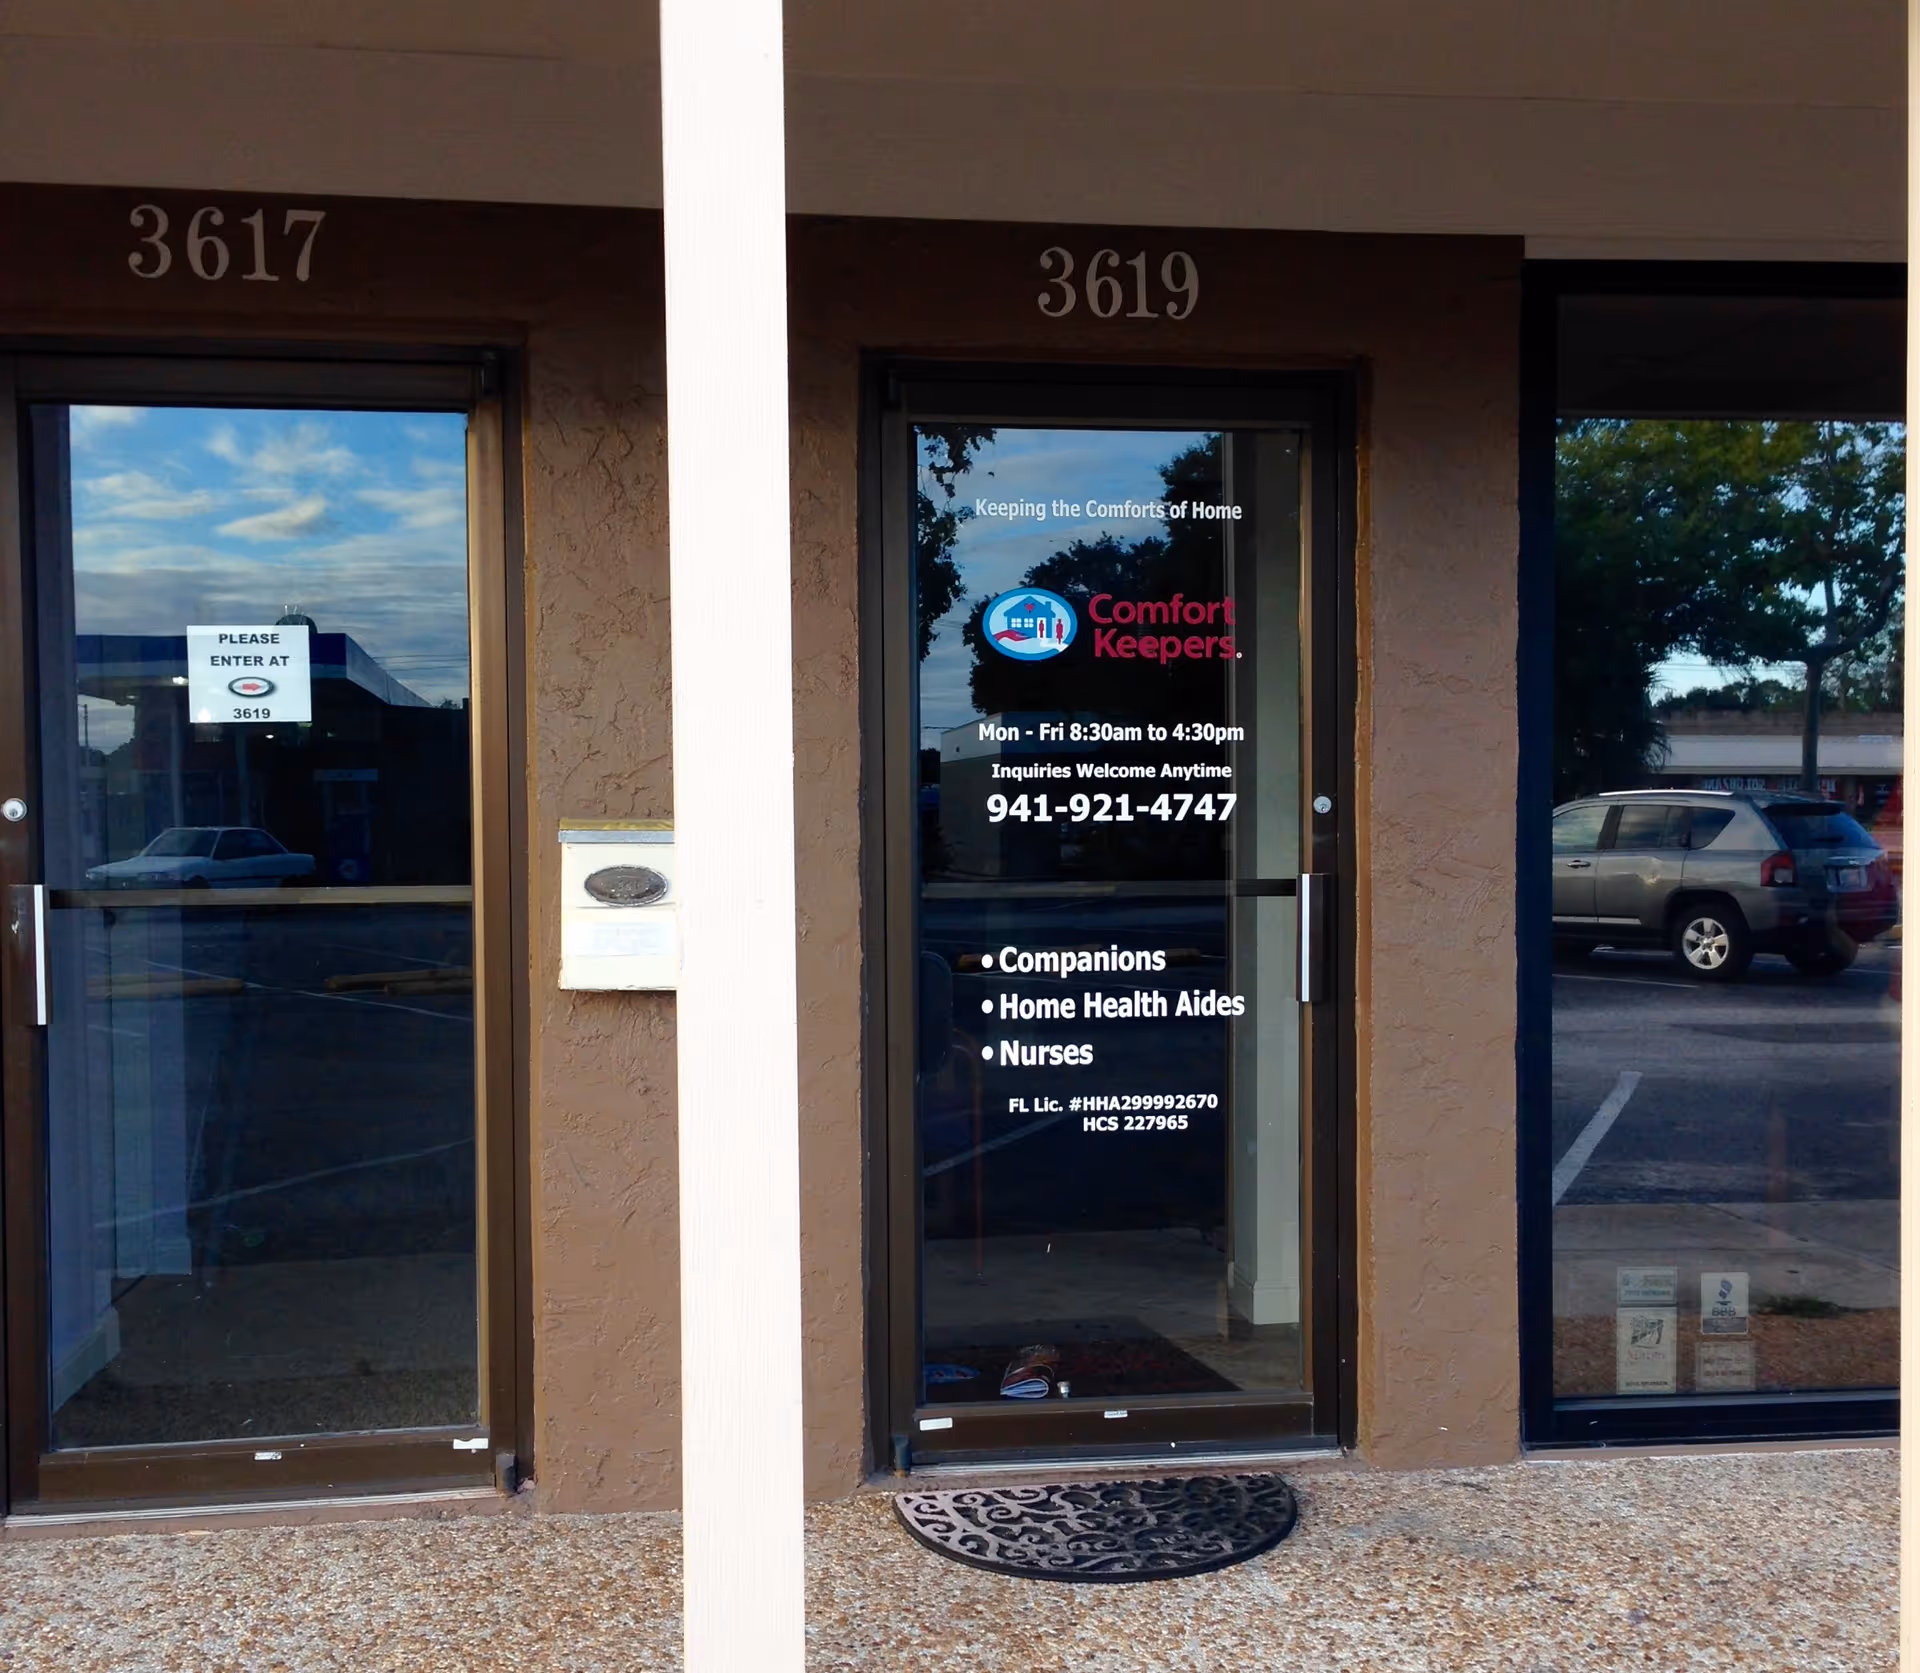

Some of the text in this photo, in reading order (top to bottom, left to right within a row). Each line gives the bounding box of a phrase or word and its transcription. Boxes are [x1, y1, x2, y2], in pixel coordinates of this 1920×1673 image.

[128, 204, 326, 282] 3617
[1038, 246, 1199, 320] 3619
[975, 498, 1243, 520] Keeping the Comforts of Home
[1088, 593, 1236, 625] Comfort
[218, 633, 280, 644] PLEASE
[210, 655, 290, 666] ENTER AT
[233, 708, 271, 719] 3619
[978, 723, 1020, 741] Mon
[1039, 722, 1064, 741] Fri
[1069, 722, 1143, 741] 8:30am
[1147, 724, 1168, 741] to
[1172, 723, 1245, 745] 4:30pm
[991, 763, 1233, 781] Inquiries Welcome Anytime
[986, 793, 1238, 823] 941-921-4747
[999, 944, 1167, 978] Companions
[1000, 989, 1246, 1019] Home Health Aides
[1000, 1040, 1094, 1066] Nurses
[1008, 1093, 1219, 1113] FL Lic. #HHA299992670
[1083, 1115, 1189, 1132] HCS 227965
